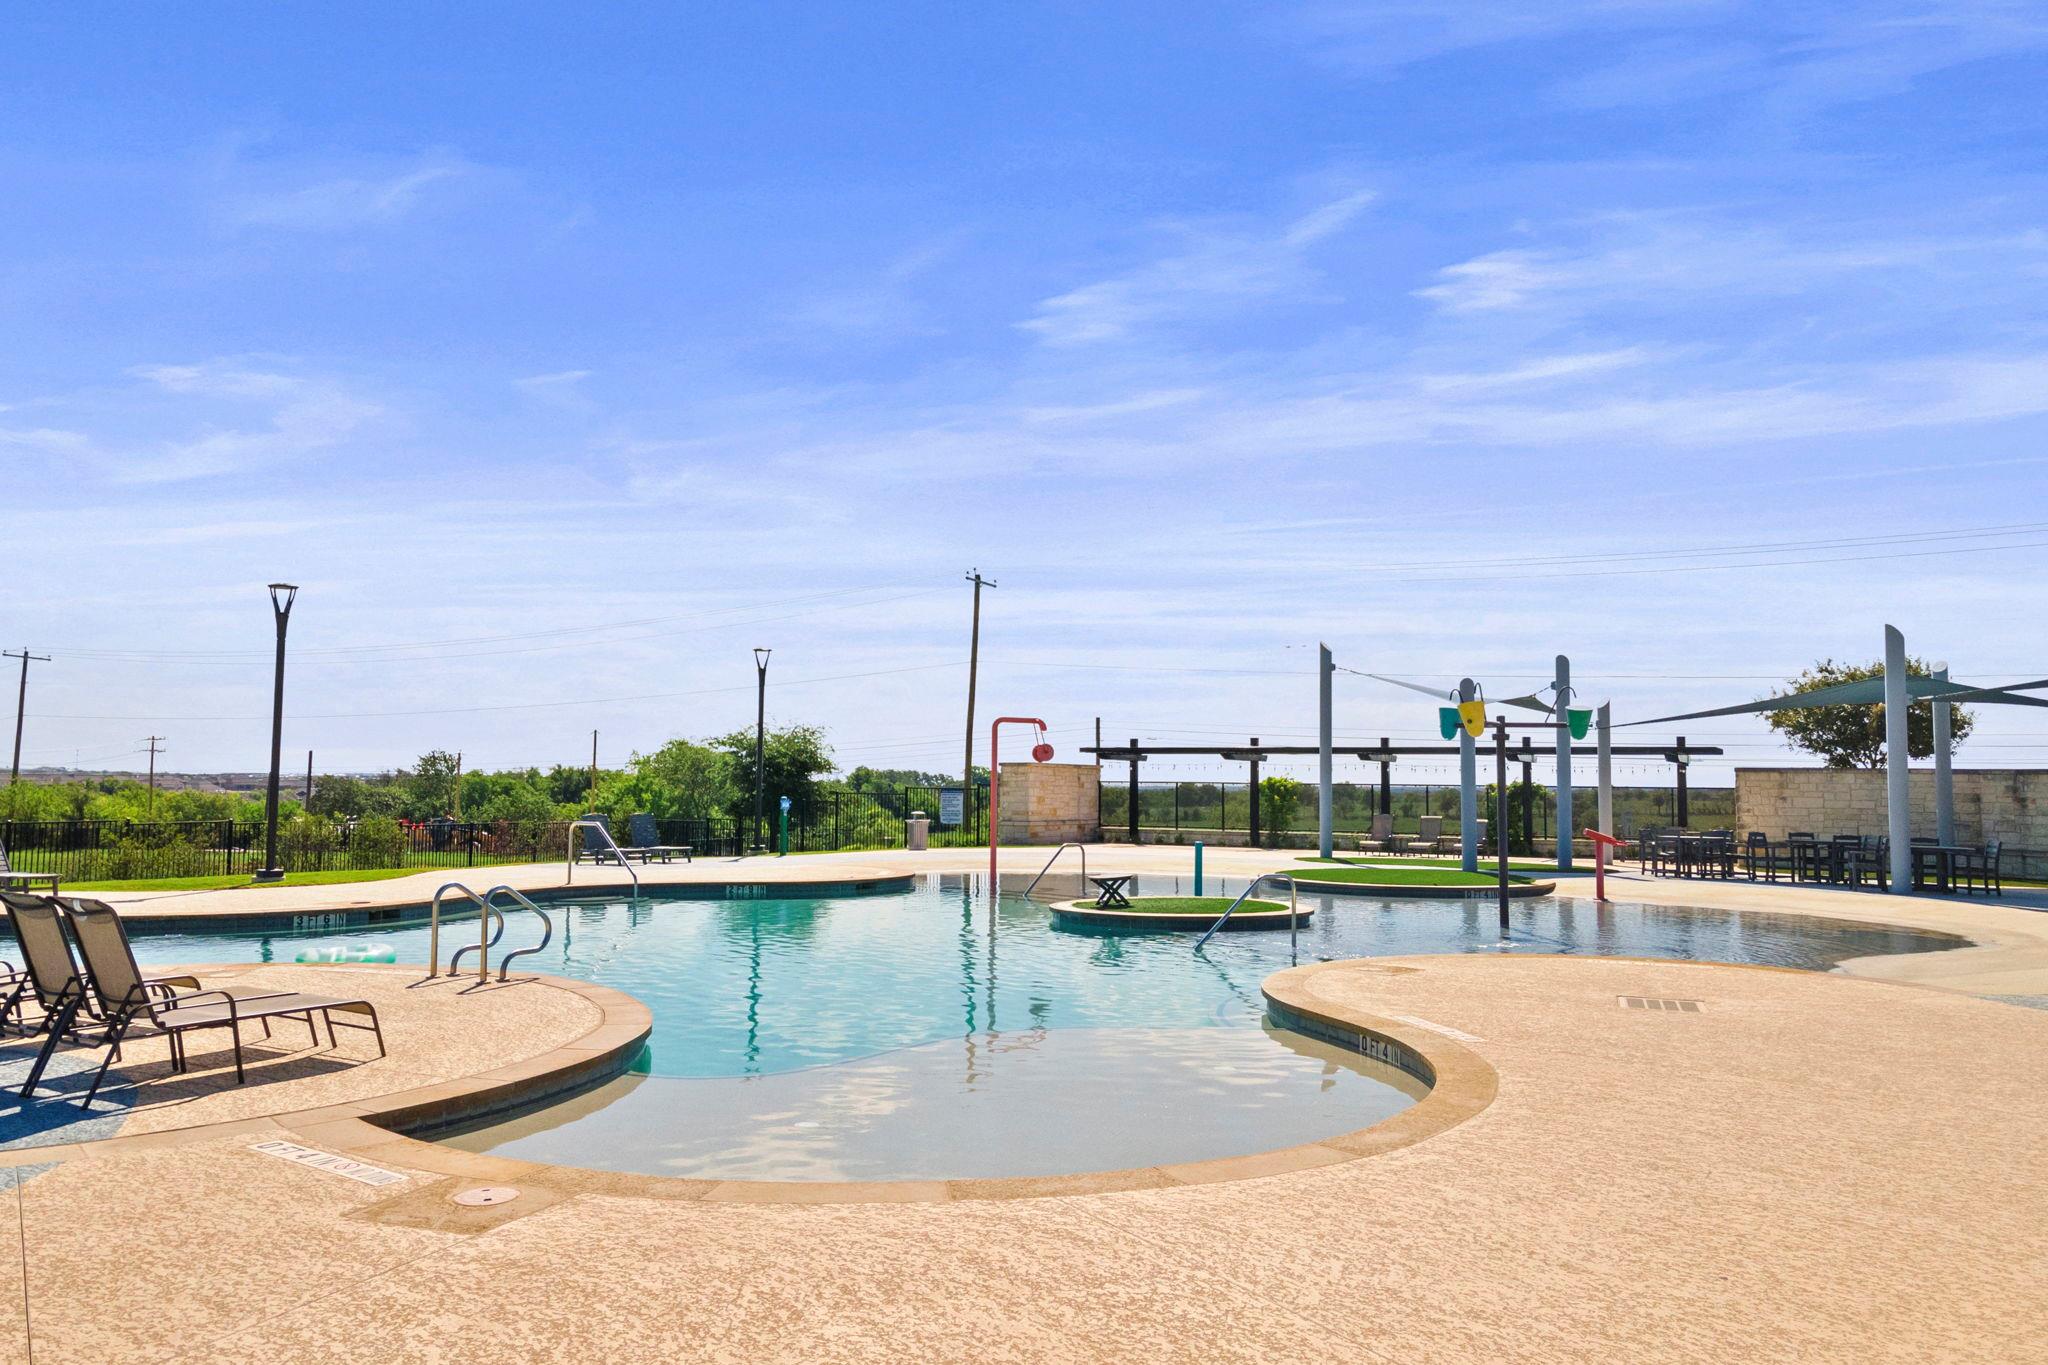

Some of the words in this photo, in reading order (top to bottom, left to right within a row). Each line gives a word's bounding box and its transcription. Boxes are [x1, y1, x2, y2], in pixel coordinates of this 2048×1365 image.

[297, 915, 304, 925] 3
[323, 914, 331, 924] 6
[1361, 1035, 1368, 1051] 0
[1370, 1039, 1380, 1056] FT
[1383, 1044, 1389, 1060] 4
